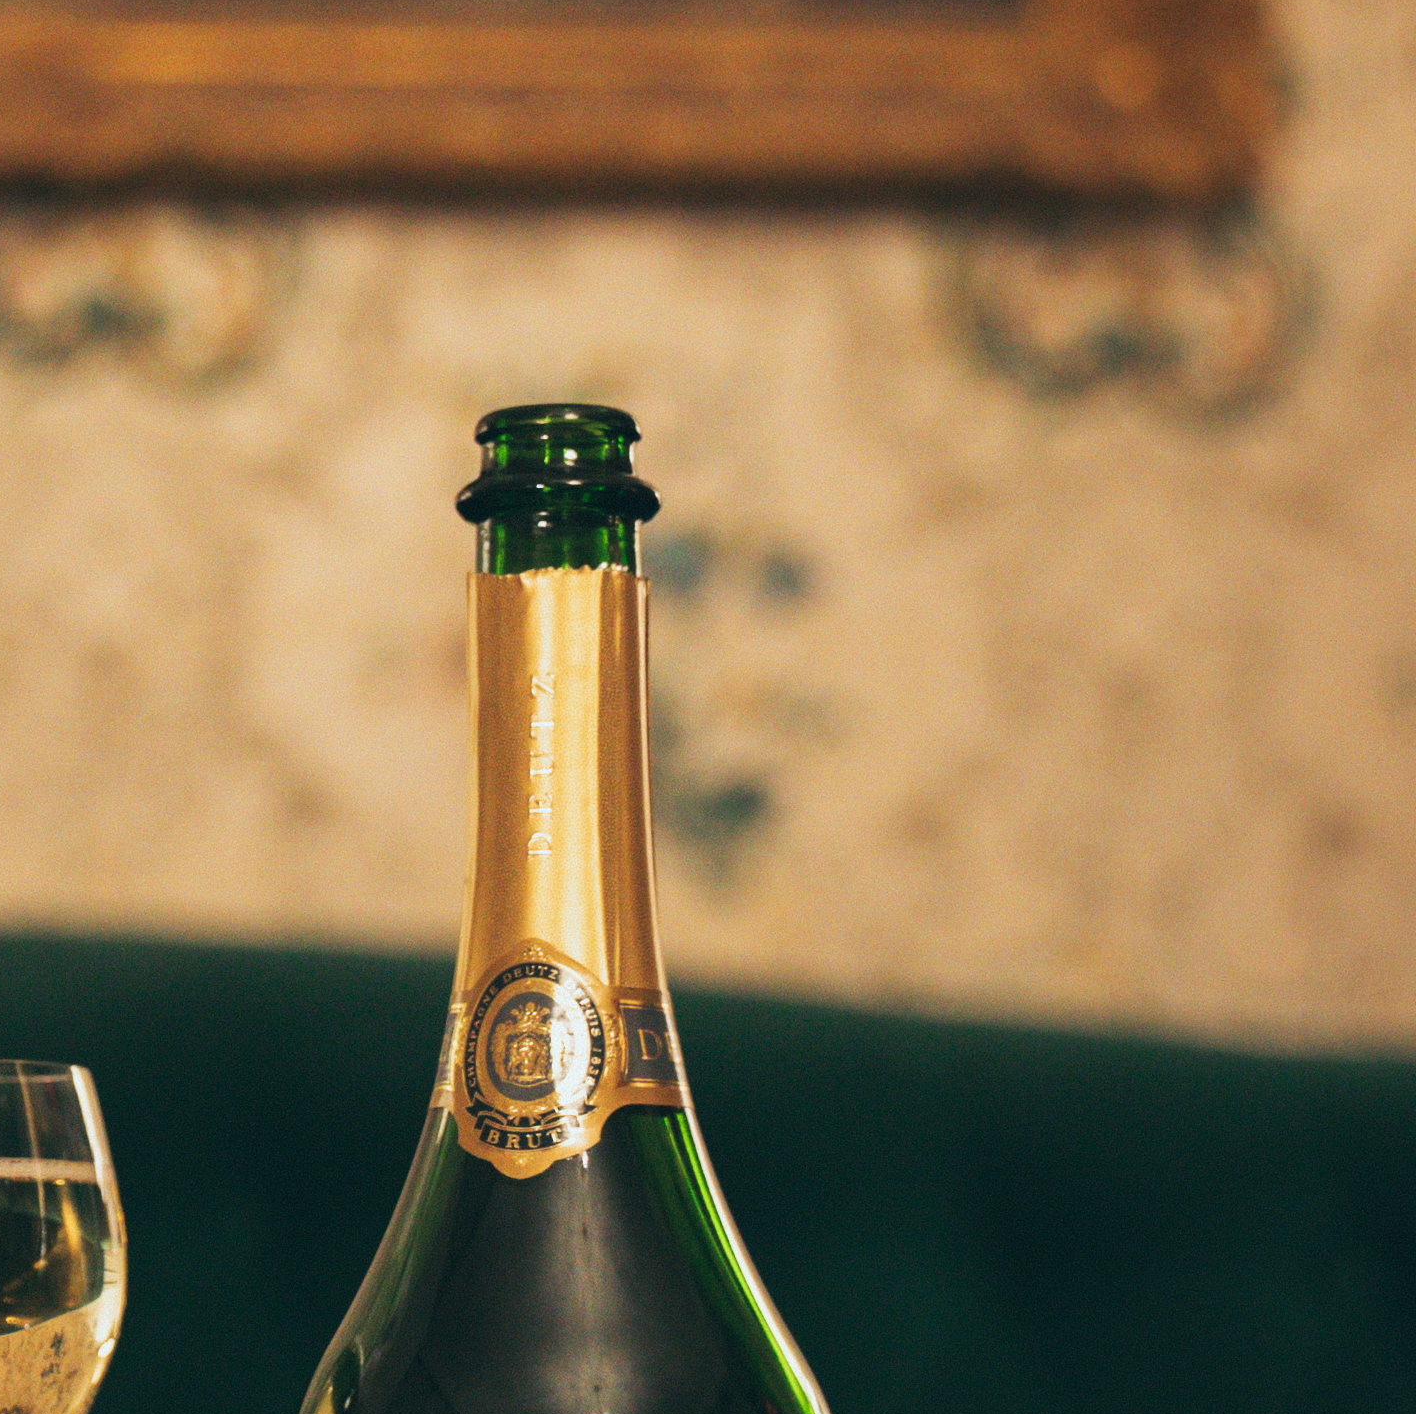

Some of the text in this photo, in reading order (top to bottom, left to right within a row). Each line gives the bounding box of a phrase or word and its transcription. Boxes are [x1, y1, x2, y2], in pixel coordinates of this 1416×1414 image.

[528, 672, 555, 859] DEUTZ
[468, 985, 498, 1087] CHAMPAGNE
[502, 964, 560, 984] DEUTZ
[487, 1127, 563, 1150] BRUT
